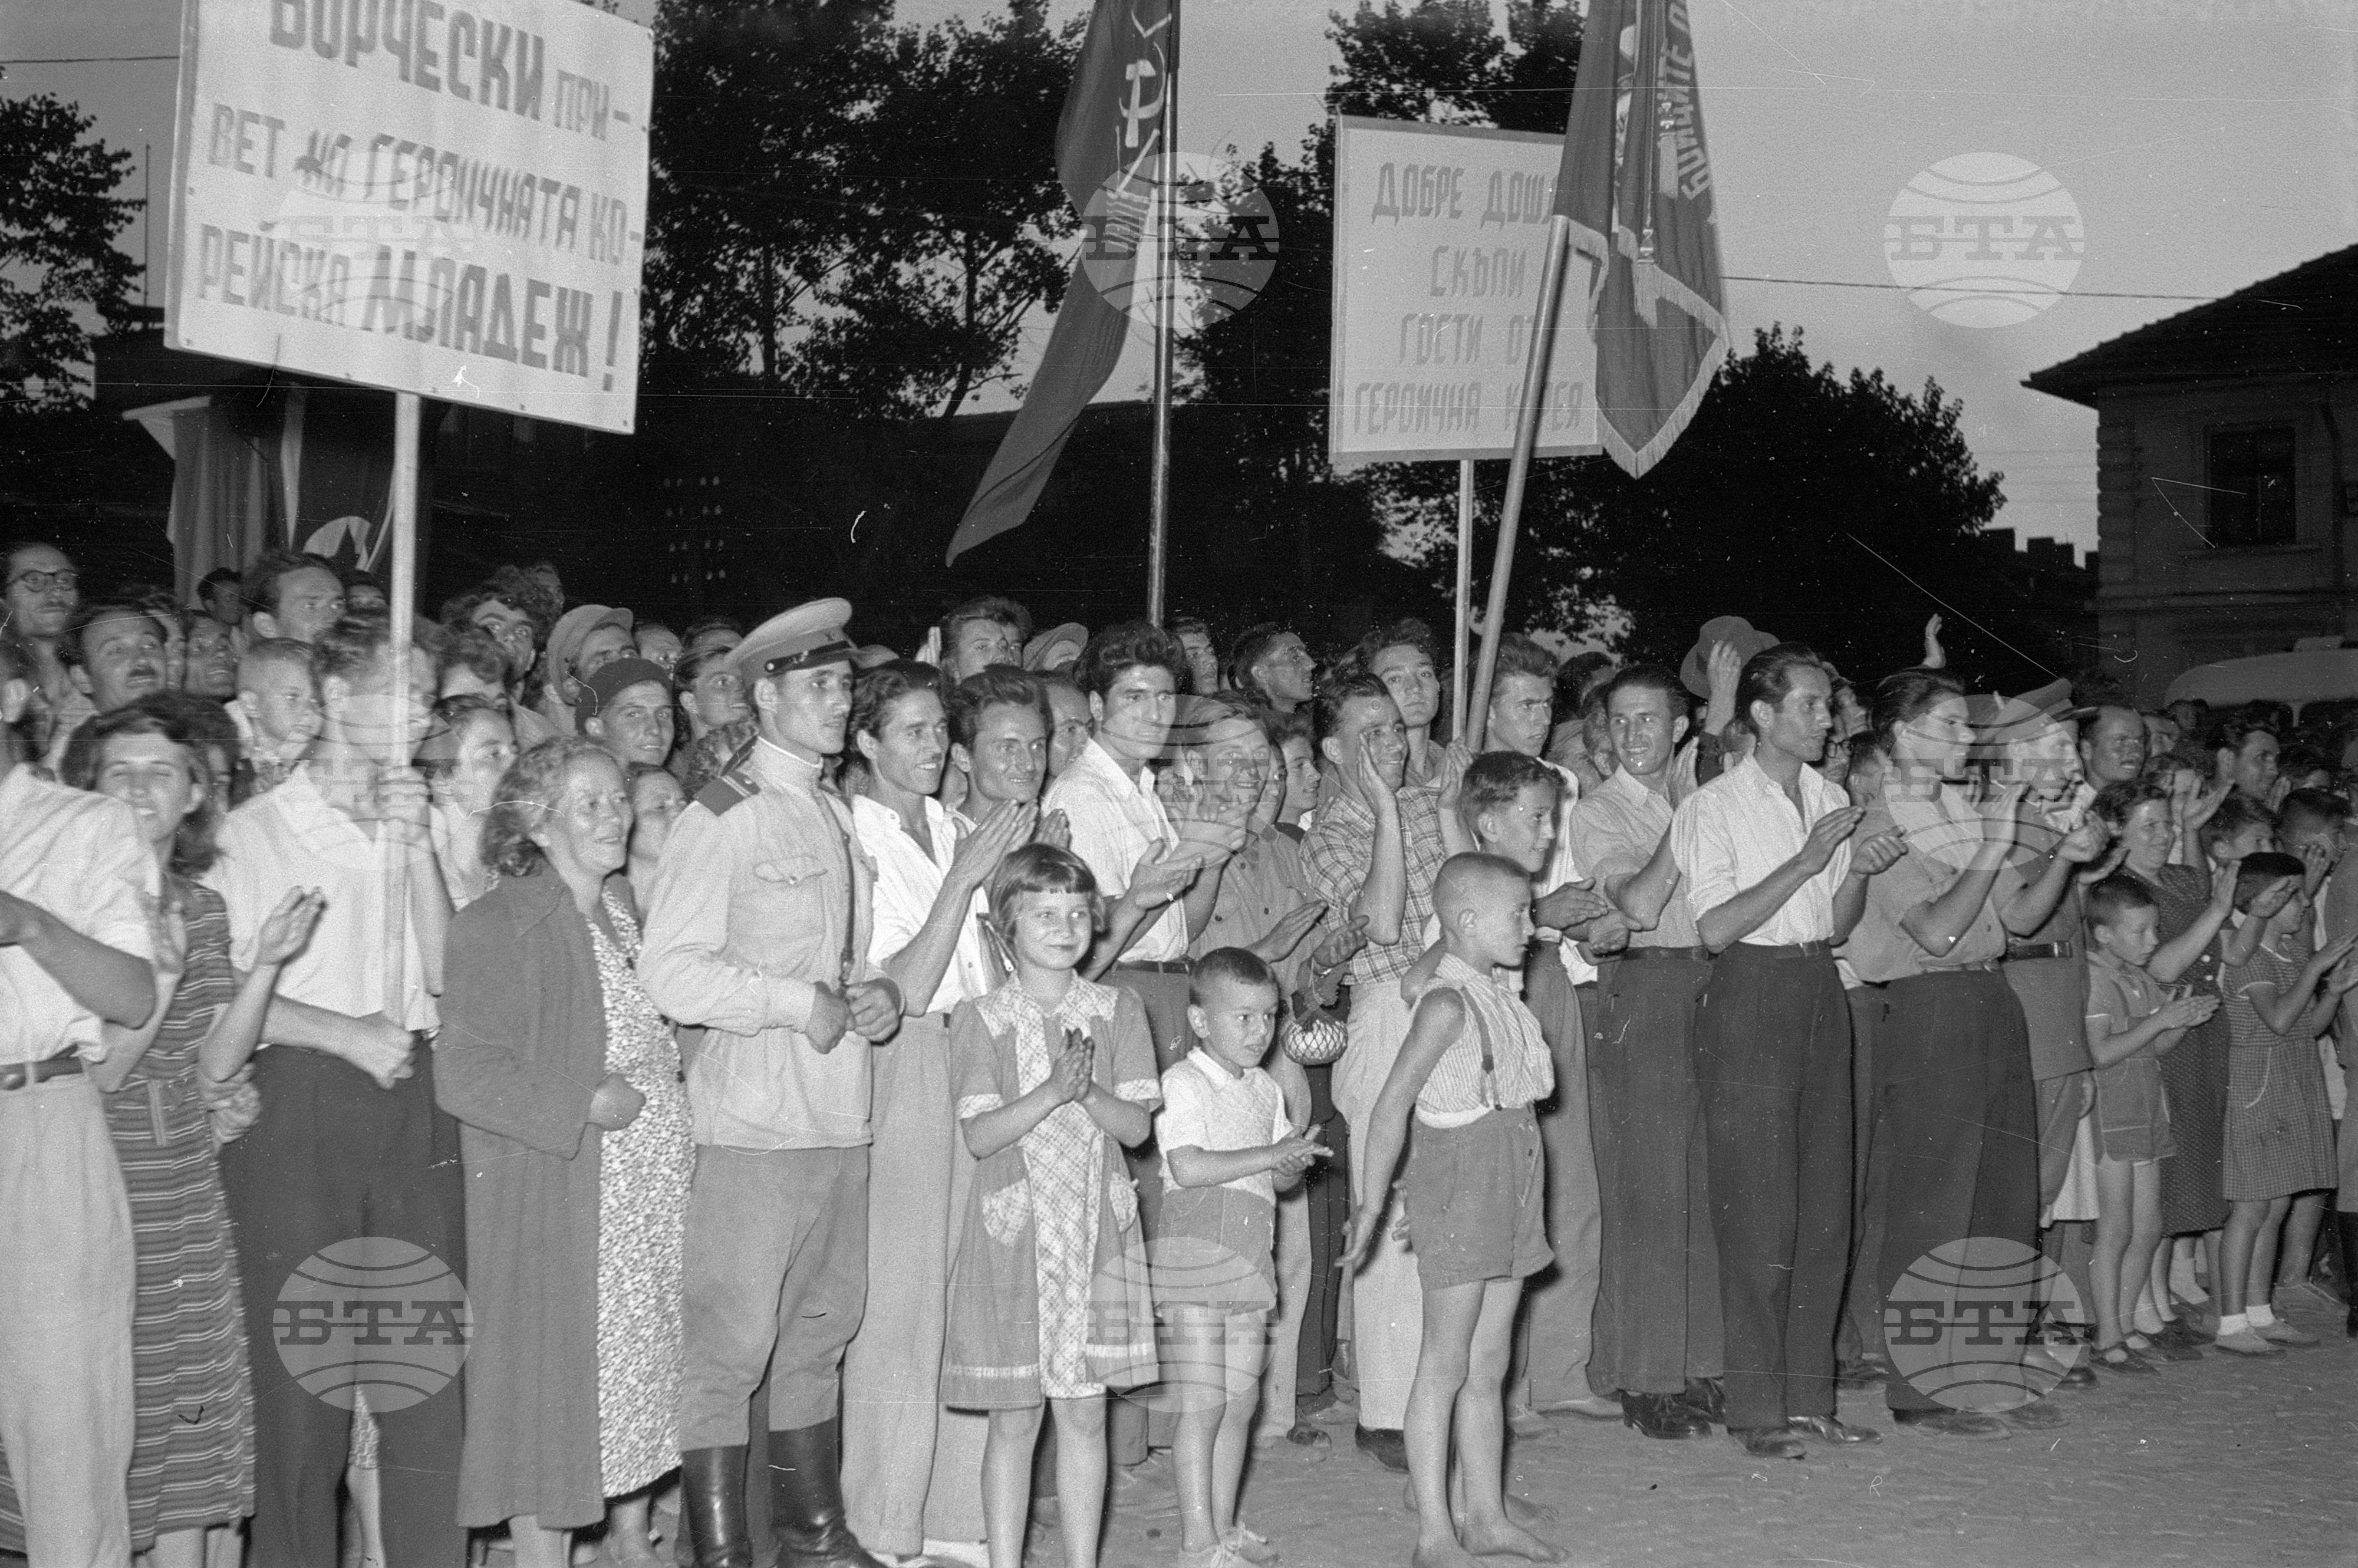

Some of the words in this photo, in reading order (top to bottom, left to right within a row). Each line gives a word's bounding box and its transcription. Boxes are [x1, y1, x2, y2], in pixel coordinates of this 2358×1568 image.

[208, 103, 286, 179] ВЕТ
[364, 133, 582, 252] ГЕРОИЧНАТА
[1371, 162, 1465, 227] ДОБРЕ
[1430, 245, 1527, 297] СКЪПИ
[1399, 312, 1484, 365] ГОСТИ
[1355, 381, 1481, 435] ГЕРОИЧНА
[1504, 380, 1584, 433] КЕЯ
